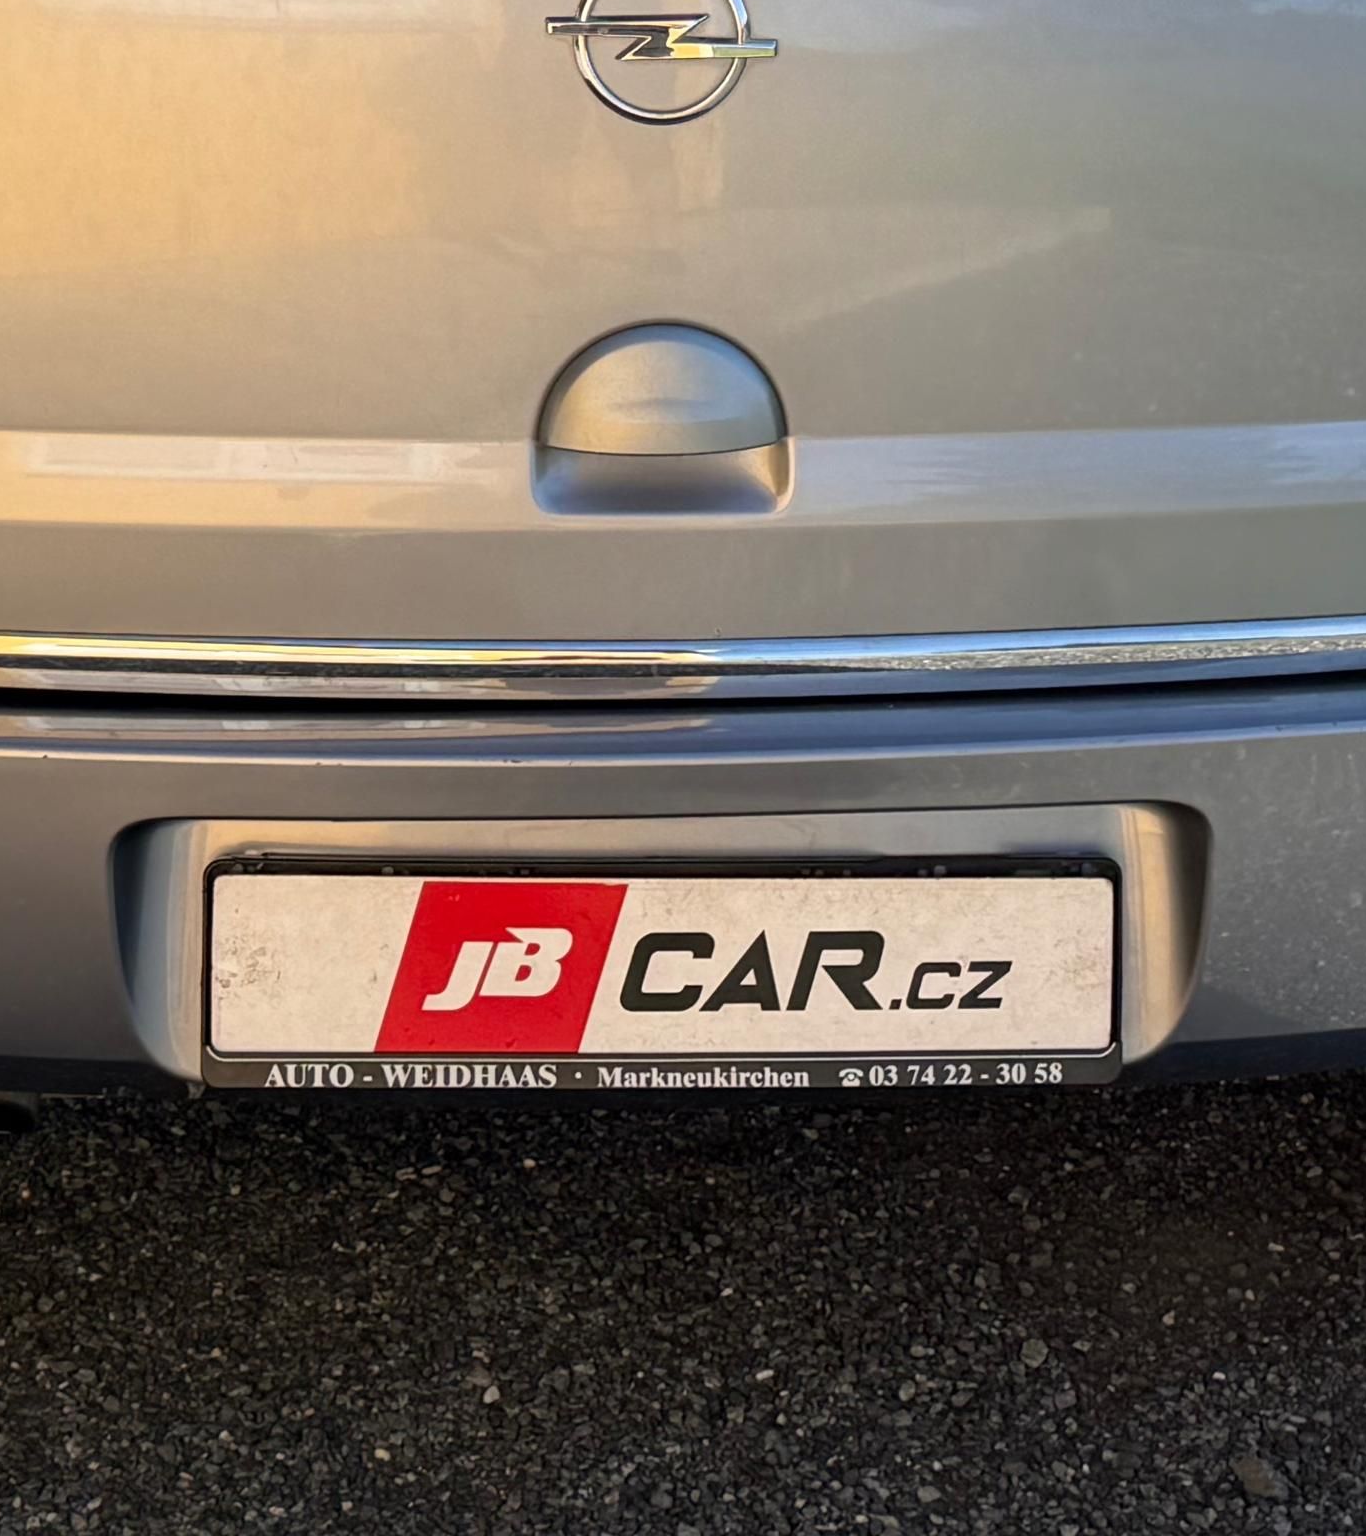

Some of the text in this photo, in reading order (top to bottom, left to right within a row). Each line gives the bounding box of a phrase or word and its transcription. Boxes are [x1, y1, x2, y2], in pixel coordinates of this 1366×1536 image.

[421, 927, 574, 1011] JB
[264, 1063, 355, 1089] AUTO
[381, 1063, 557, 1089] WEIDHAAS
[597, 1065, 811, 1089] Markneukirchen
[868, 1064, 898, 1087] 03
[906, 1064, 936, 1086] 74
[943, 1063, 973, 1086] 22
[995, 1063, 1027, 1085] 30
[1034, 1062, 1064, 1084] 58
